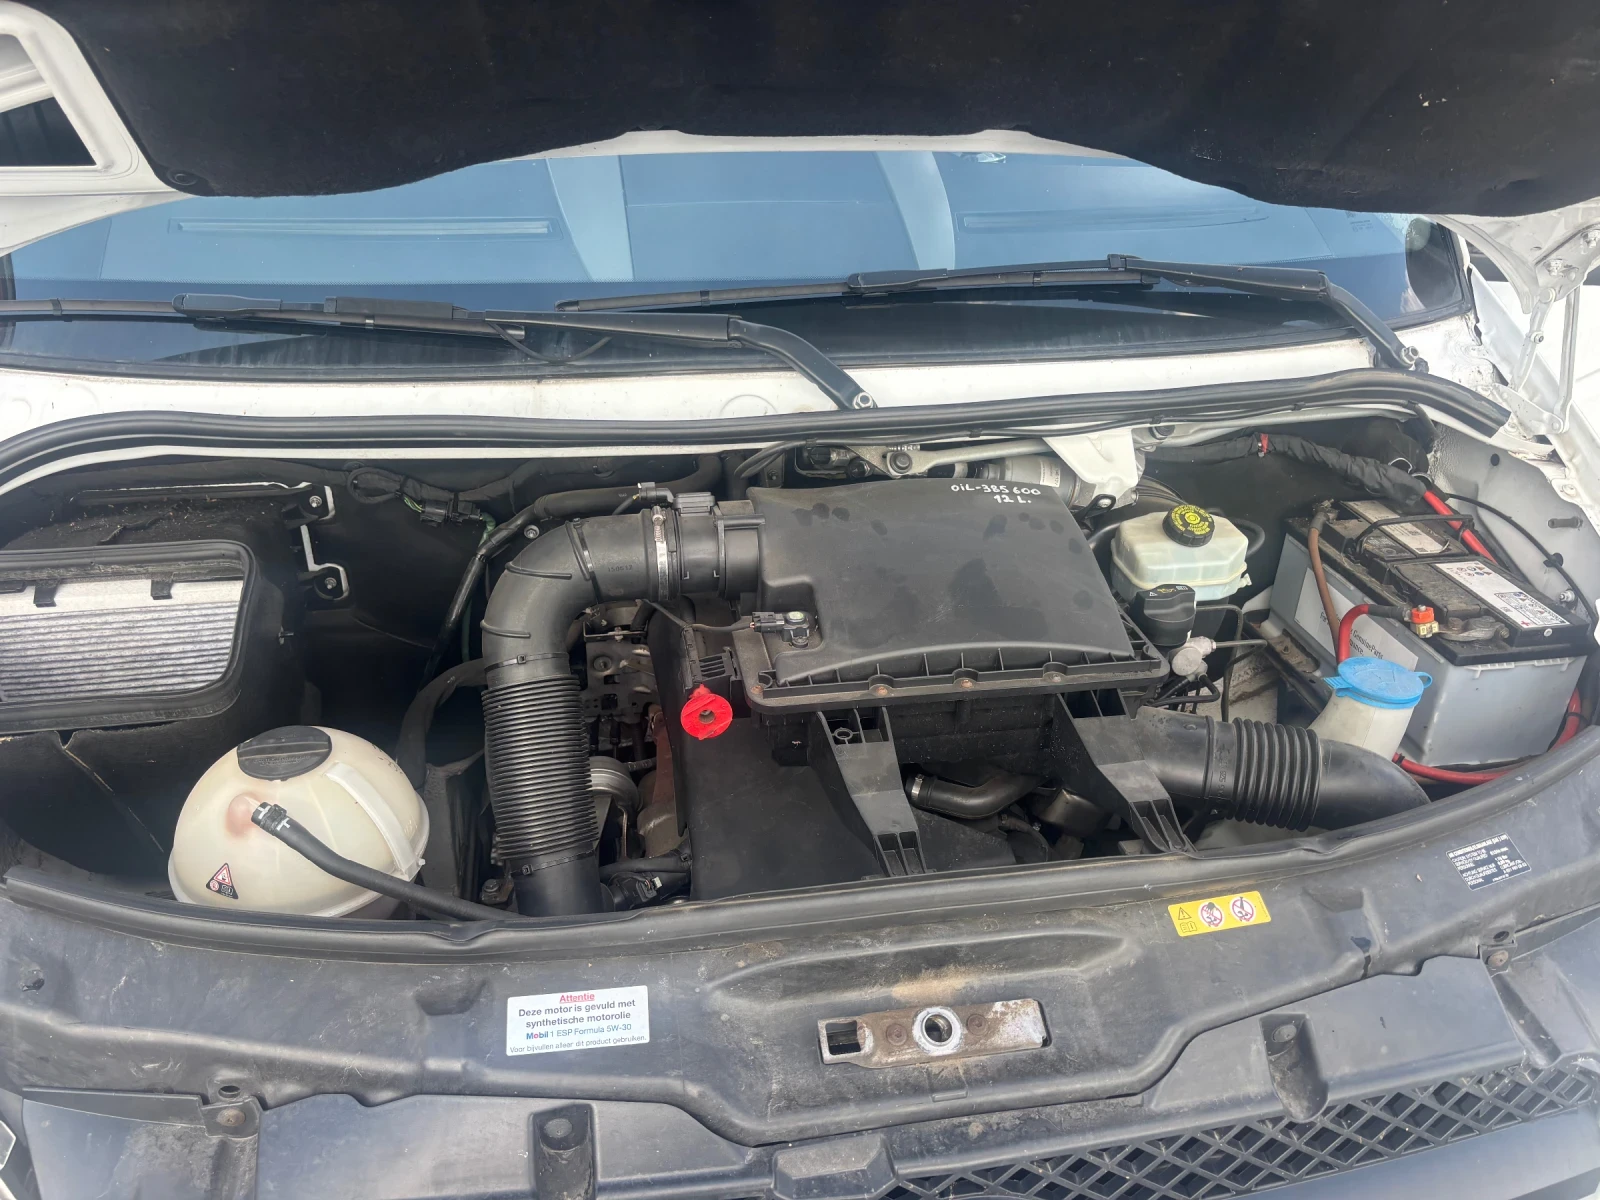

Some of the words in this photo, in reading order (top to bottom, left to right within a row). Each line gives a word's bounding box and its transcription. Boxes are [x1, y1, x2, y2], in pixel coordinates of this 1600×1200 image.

[1012, 486, 1041, 495] 600
[993, 494, 1014, 504] 12
[560, 992, 595, 1004] Attentie
[518, 1008, 542, 1017] Deze
[544, 1005, 573, 1015] motor
[574, 1004, 582, 1012] is
[585, 1001, 616, 1013] gevuld
[618, 999, 636, 1008] met
[526, 1014, 585, 1029] synthetische
[587, 1011, 631, 1023] motorolie
[526, 1030, 549, 1040] Mobil
[556, 1028, 573, 1037] ESP
[574, 1026, 605, 1036] Formula
[606, 1023, 632, 1032] 5W-30
[527, 1043, 554, 1053] bijvullen
[586, 1038, 611, 1048] product
